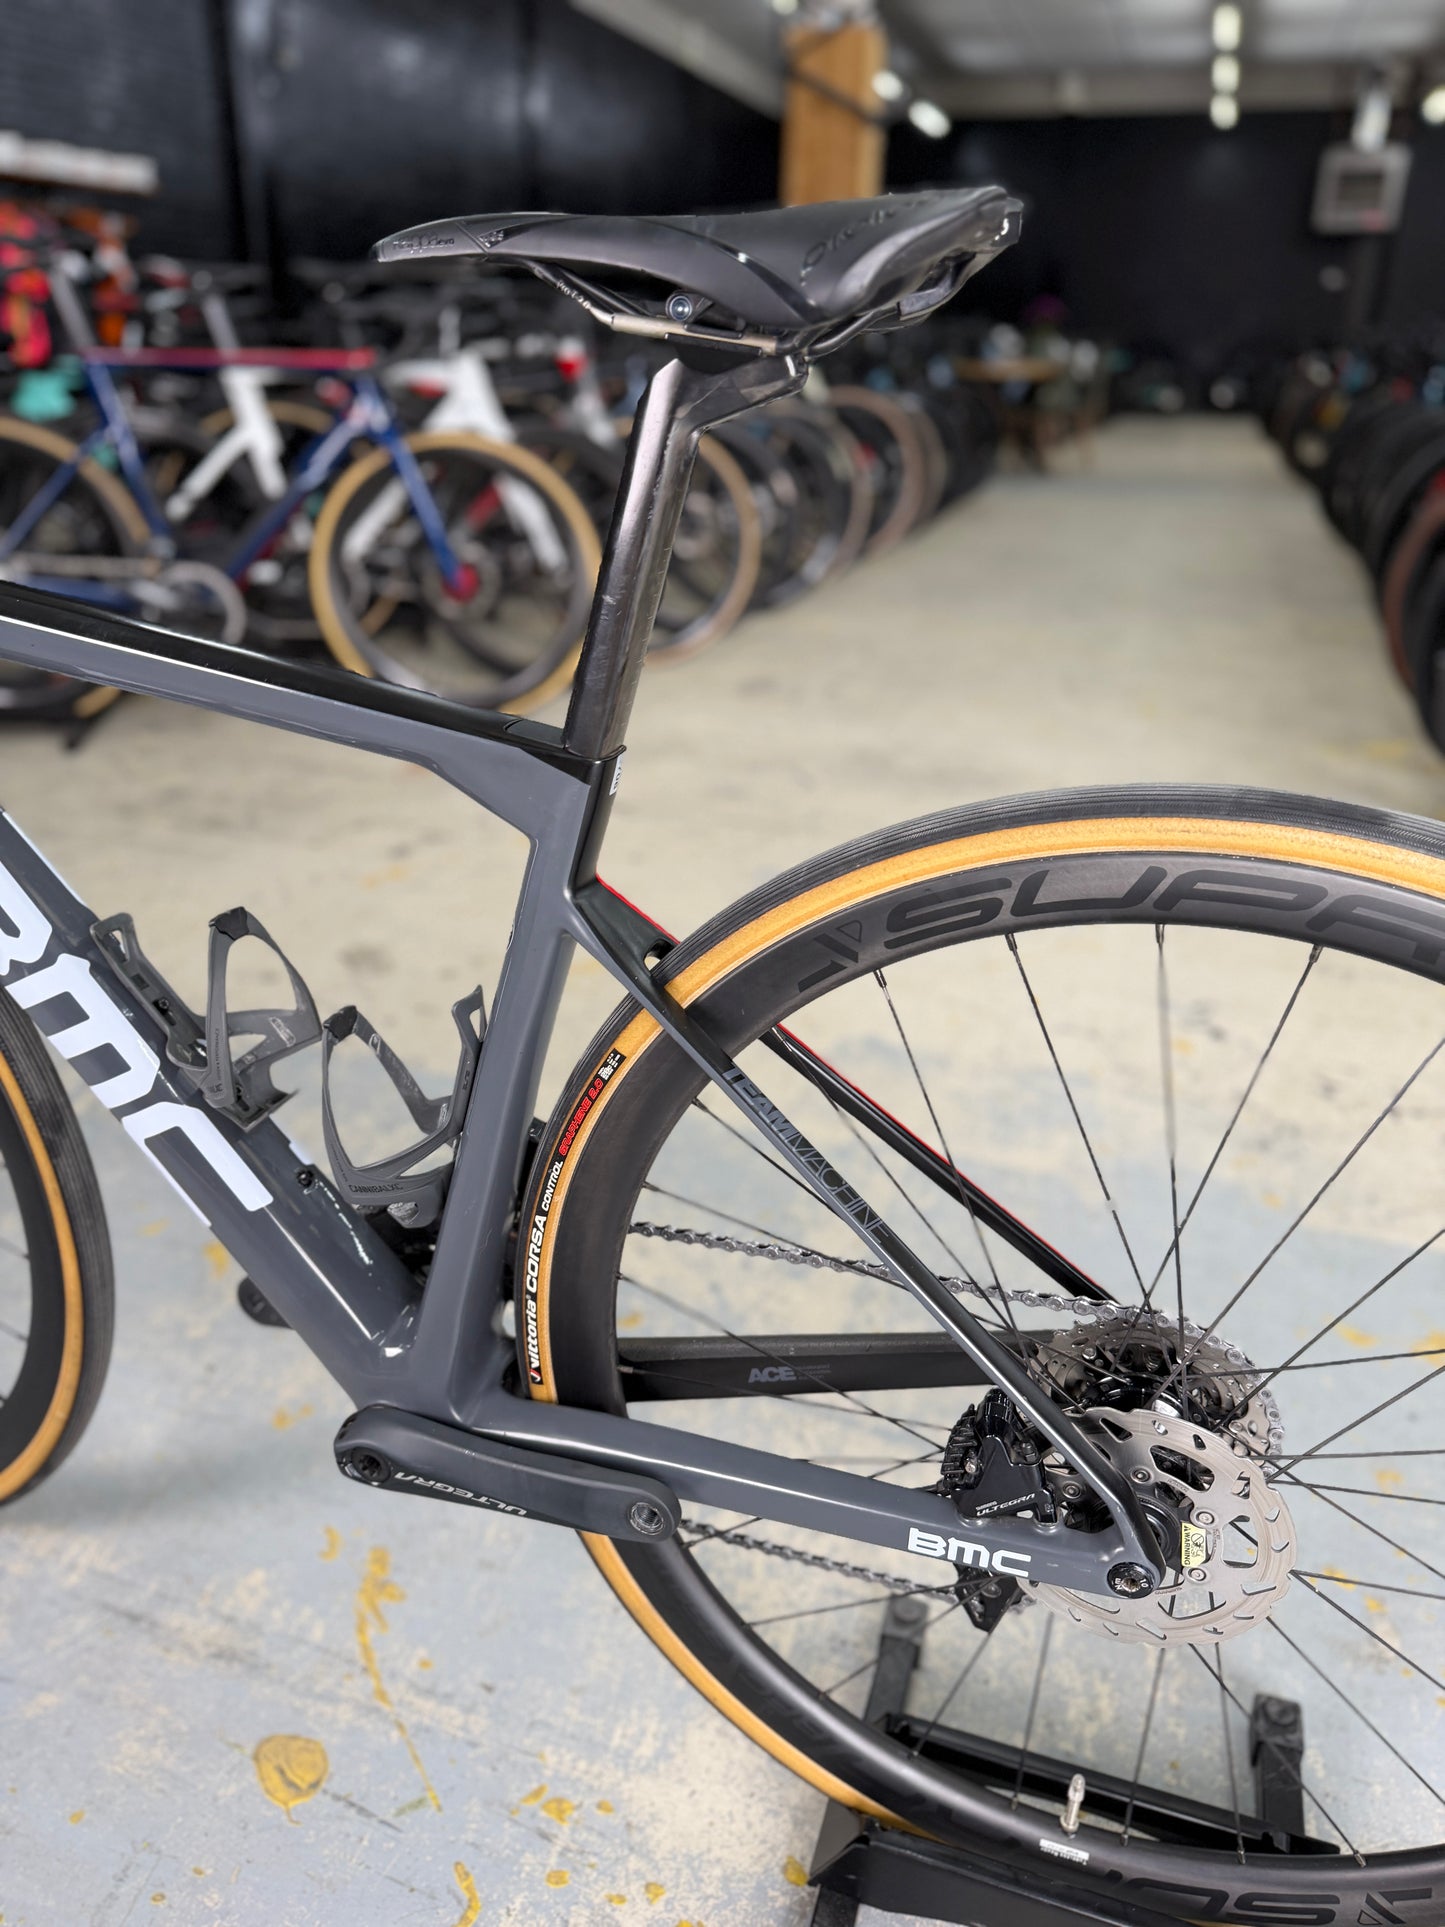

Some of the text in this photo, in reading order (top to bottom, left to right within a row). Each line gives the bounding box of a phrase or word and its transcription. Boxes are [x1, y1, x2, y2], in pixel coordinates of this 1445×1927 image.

[526, 1215, 547, 1293] CORSA
[541, 1161, 563, 1212] CONTROL
[558, 1097, 592, 1155] GRAPHENE
[588, 1078, 604, 1100] 2.0
[747, 1366, 797, 1384] ACE
[394, 1471, 528, 1516] ULTEGRA
[976, 1493, 1036, 1517] ULTEGRA
[908, 1527, 1032, 1578] BMC
[1183, 1532, 1191, 1566] WARNING
